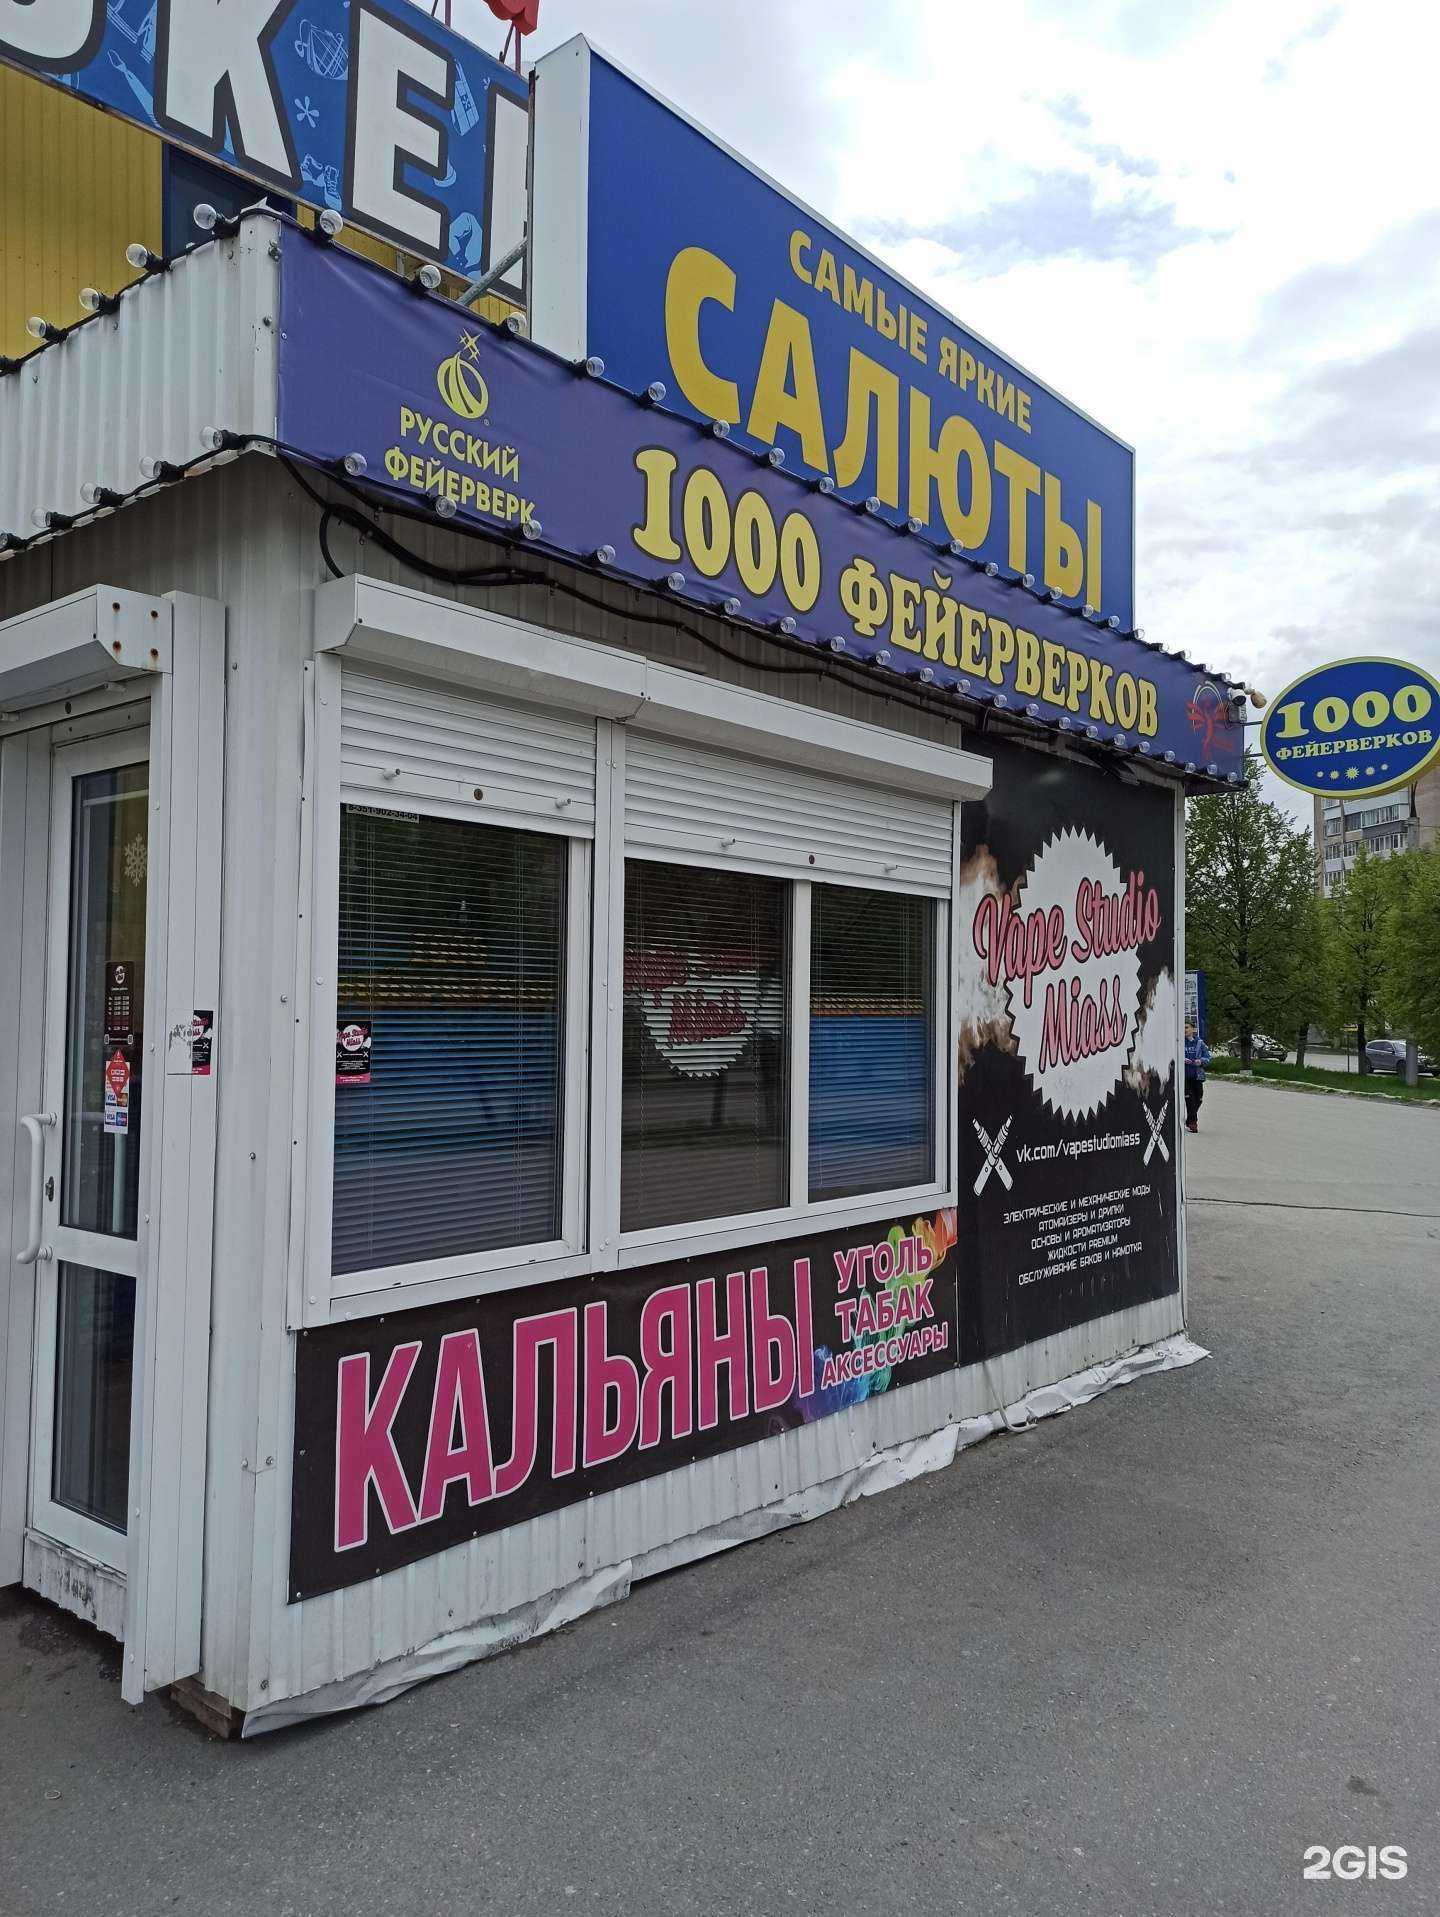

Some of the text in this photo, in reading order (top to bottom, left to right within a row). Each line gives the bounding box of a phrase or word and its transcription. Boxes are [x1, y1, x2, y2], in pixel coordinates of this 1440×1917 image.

[789, 229, 1033, 434] САМЫЕ ЯРКИЕ
[400, 406, 519, 483] РУССКИЙ
[664, 246, 1103, 613] САЛЮТЫ
[384, 446, 536, 524] ФЕЙЕРВЕРК
[632, 447, 1160, 739] 1000 ФЕЙЕРВЕРКОВ
[1275, 729, 1433, 760] ФЕЙЕРВЕРКОВ
[1276, 685, 1432, 739] 1000
[973, 893, 1068, 1008] Vape
[1071, 869, 1162, 964] Studio
[1039, 974, 1128, 1073] Miass
[1016, 1131, 1140, 1163] vk.com/vapestudiomiass
[1003, 1184, 1151, 1224] ЭЛЕКТРИЧЕСКИЕ И МЕХАНИЧЕСКИЕ МОДЫ
[1031, 1216, 1131, 1250] ОСНОВЫ И АРОМАТИЗАТОРЫ
[1090, 1209, 1096, 1220] И
[1099, 1203, 1125, 1219] ДРИПКИ
[834, 1235, 934, 1295] УГОЛЬ
[1018, 1241, 1143, 1285] ОБСЛУЖИВАНИЕ БАКОВ И НАМОТКА
[1047, 1234, 1118, 1261] ЖИДКОСТИ PREMIUM
[834, 1278, 935, 1345] ТАБАК
[820, 1321, 949, 1389] АКСЕССУАРЫ
[334, 1258, 813, 1552] КАЛЬЯНЫ
